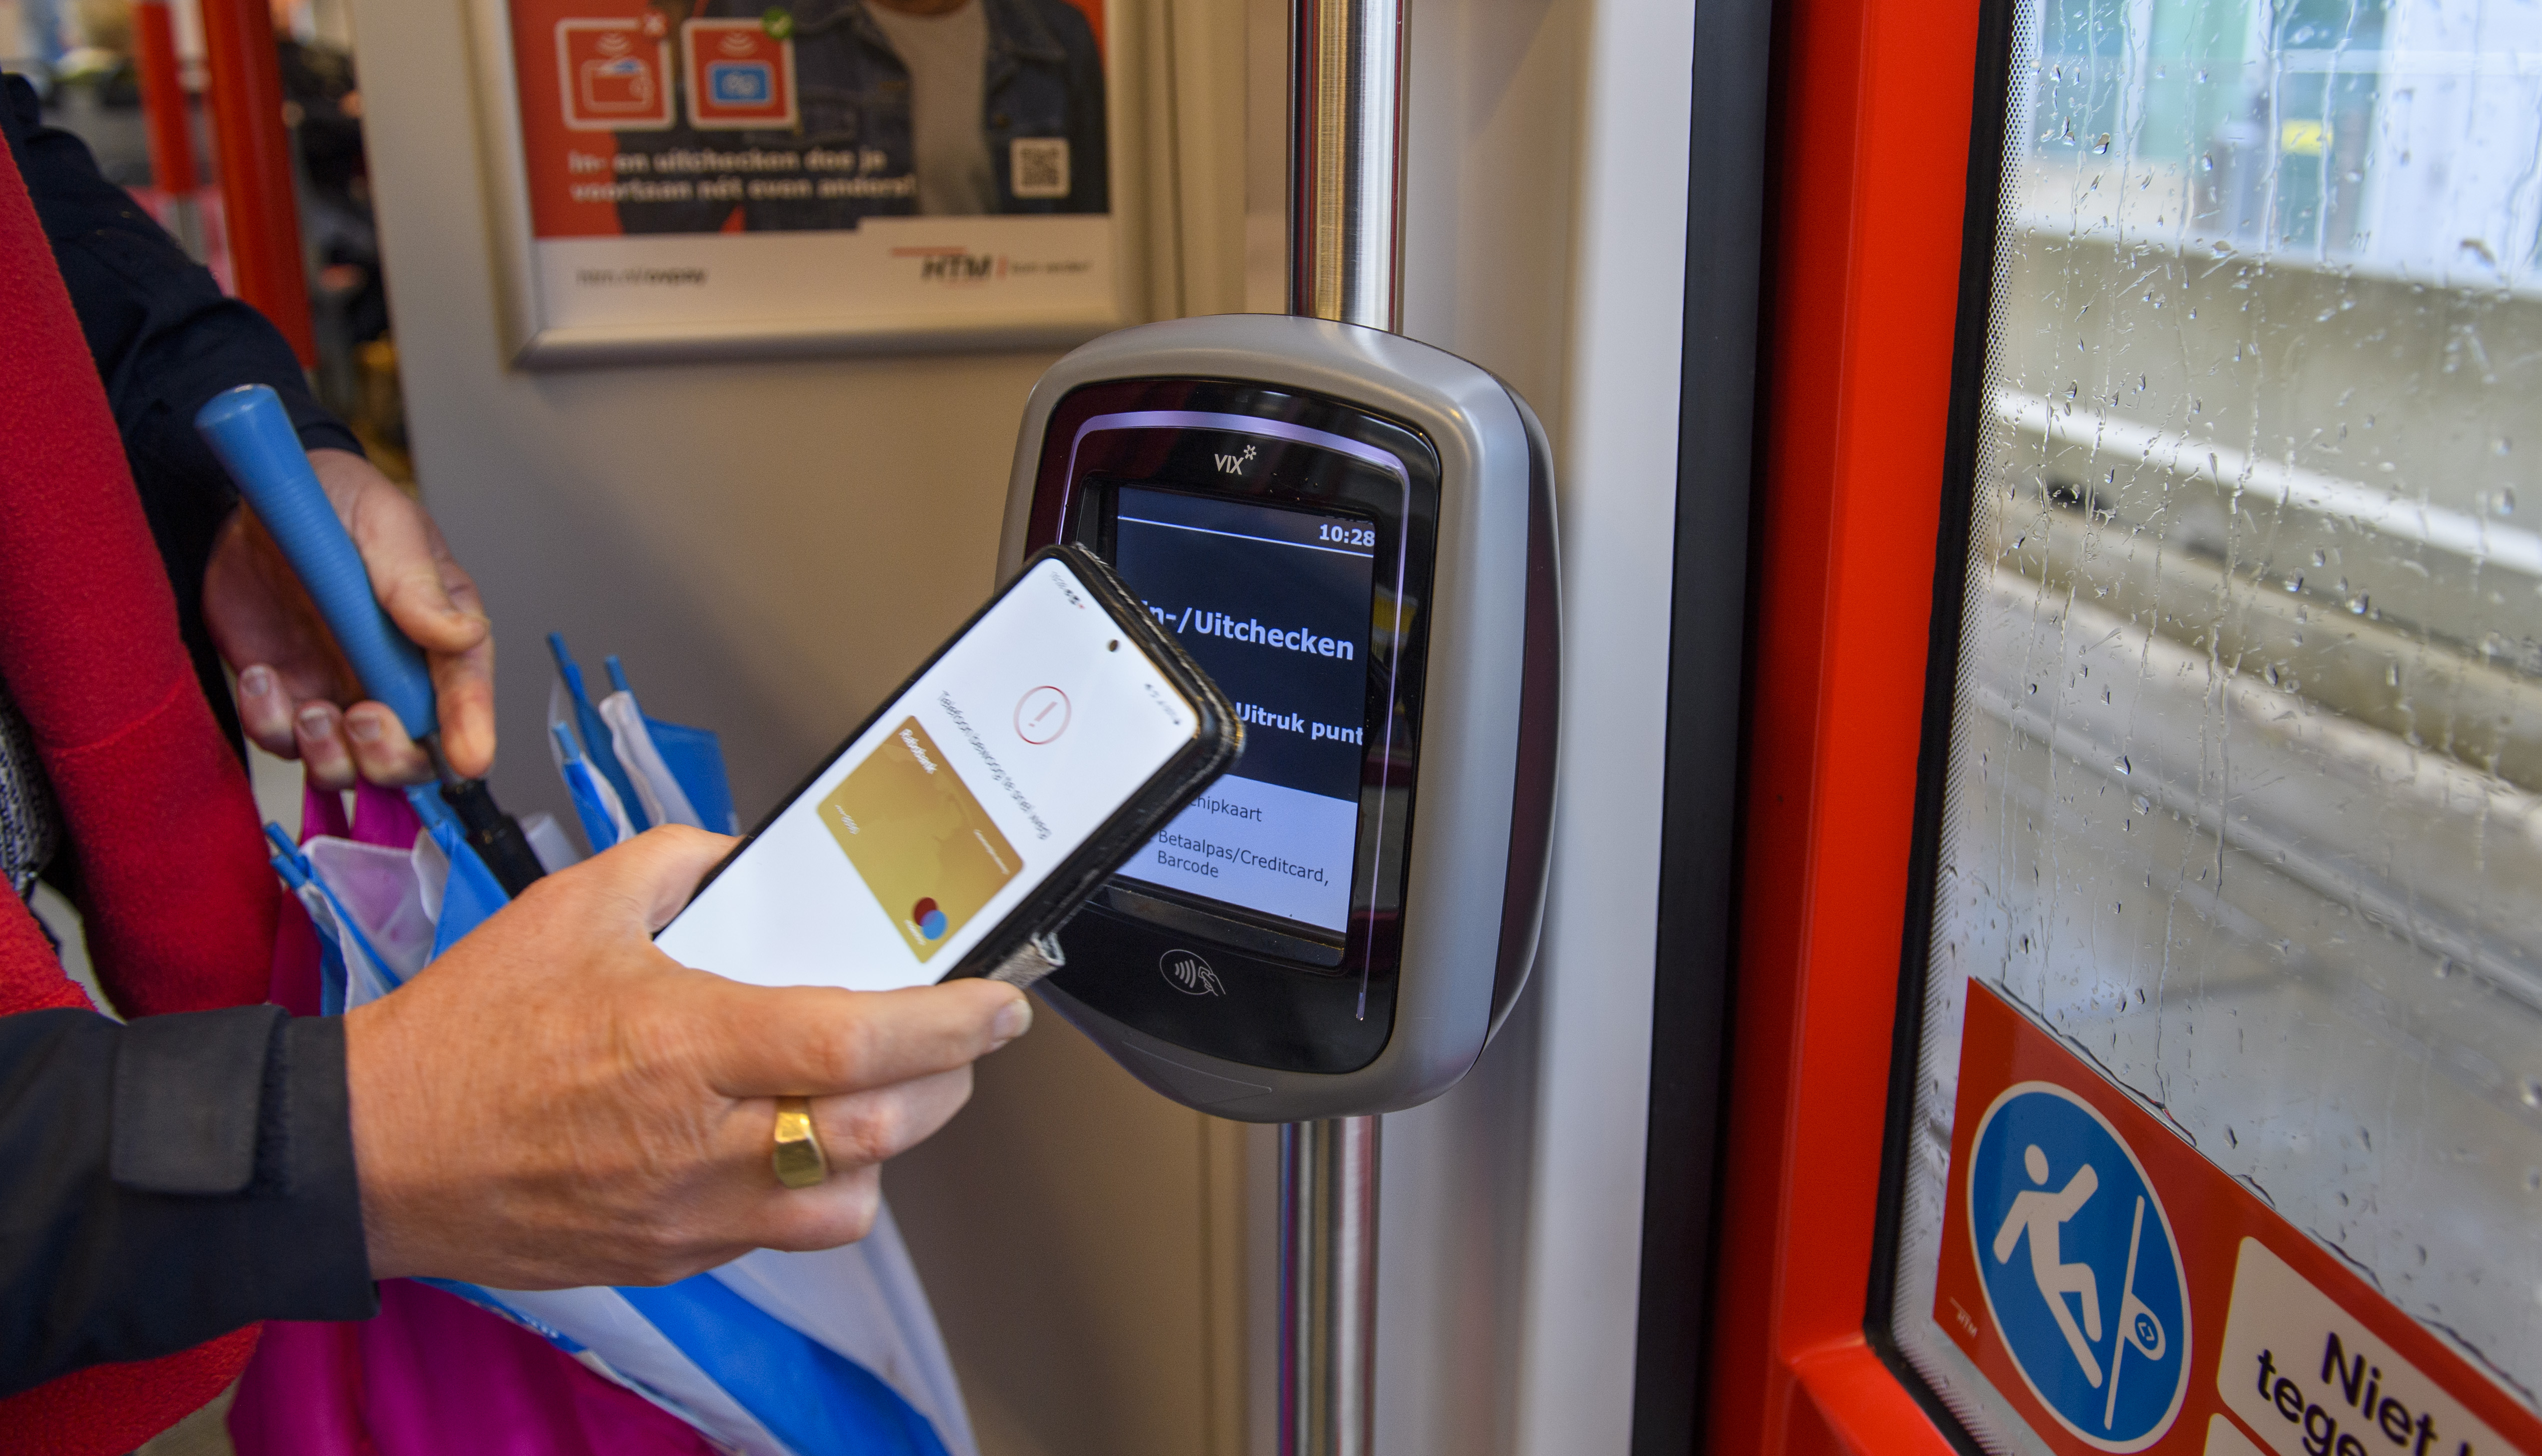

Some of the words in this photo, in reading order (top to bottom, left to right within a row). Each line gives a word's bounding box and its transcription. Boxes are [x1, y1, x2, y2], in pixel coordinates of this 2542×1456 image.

[613, 152, 649, 174] en
[653, 146, 799, 174] uitchecken
[570, 178, 693, 202] voortaan
[748, 178, 814, 200] even
[921, 253, 992, 280] HTM
[1214, 454, 1244, 475] VIX
[1319, 524, 1375, 547] 10:28
[1141, 600, 1353, 660] n-/Uitchecken
[1235, 702, 1305, 734] Uitruk
[1311, 721, 1363, 746] punt
[1158, 830, 1329, 886] Betaalpas/Creditcard,
[1158, 850, 1219, 878] Barcode
[2321, 1331, 2439, 1456] Niet
